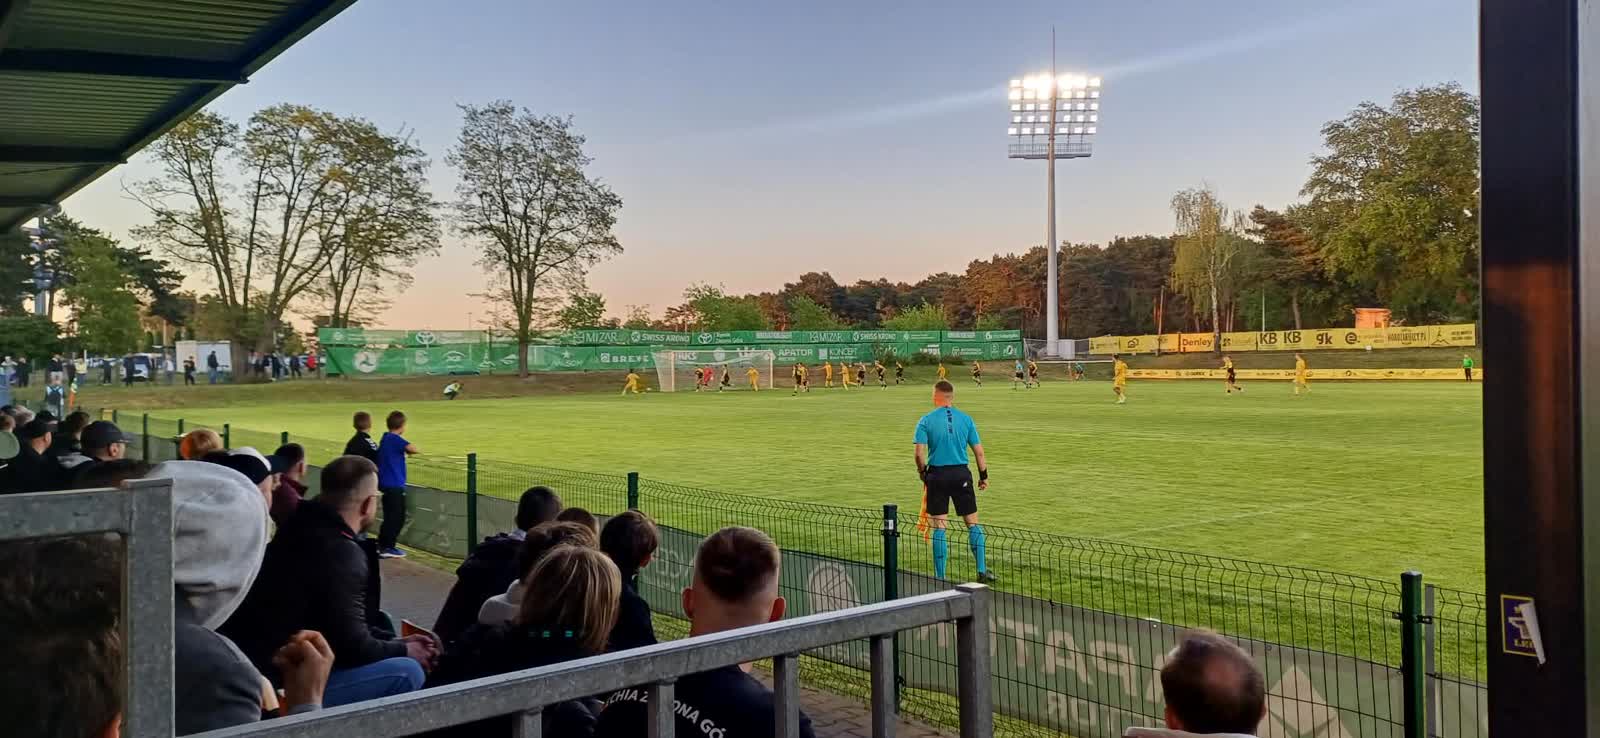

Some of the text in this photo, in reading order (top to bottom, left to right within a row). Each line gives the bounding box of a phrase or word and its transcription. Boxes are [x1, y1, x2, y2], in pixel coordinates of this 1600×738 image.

[1183, 338, 1212, 347] Denley
[1260, 332, 1277, 344] KB
[1284, 331, 1301, 344] KB
[1317, 332, 1332, 344] gk
[778, 348, 813, 356] APATOR
